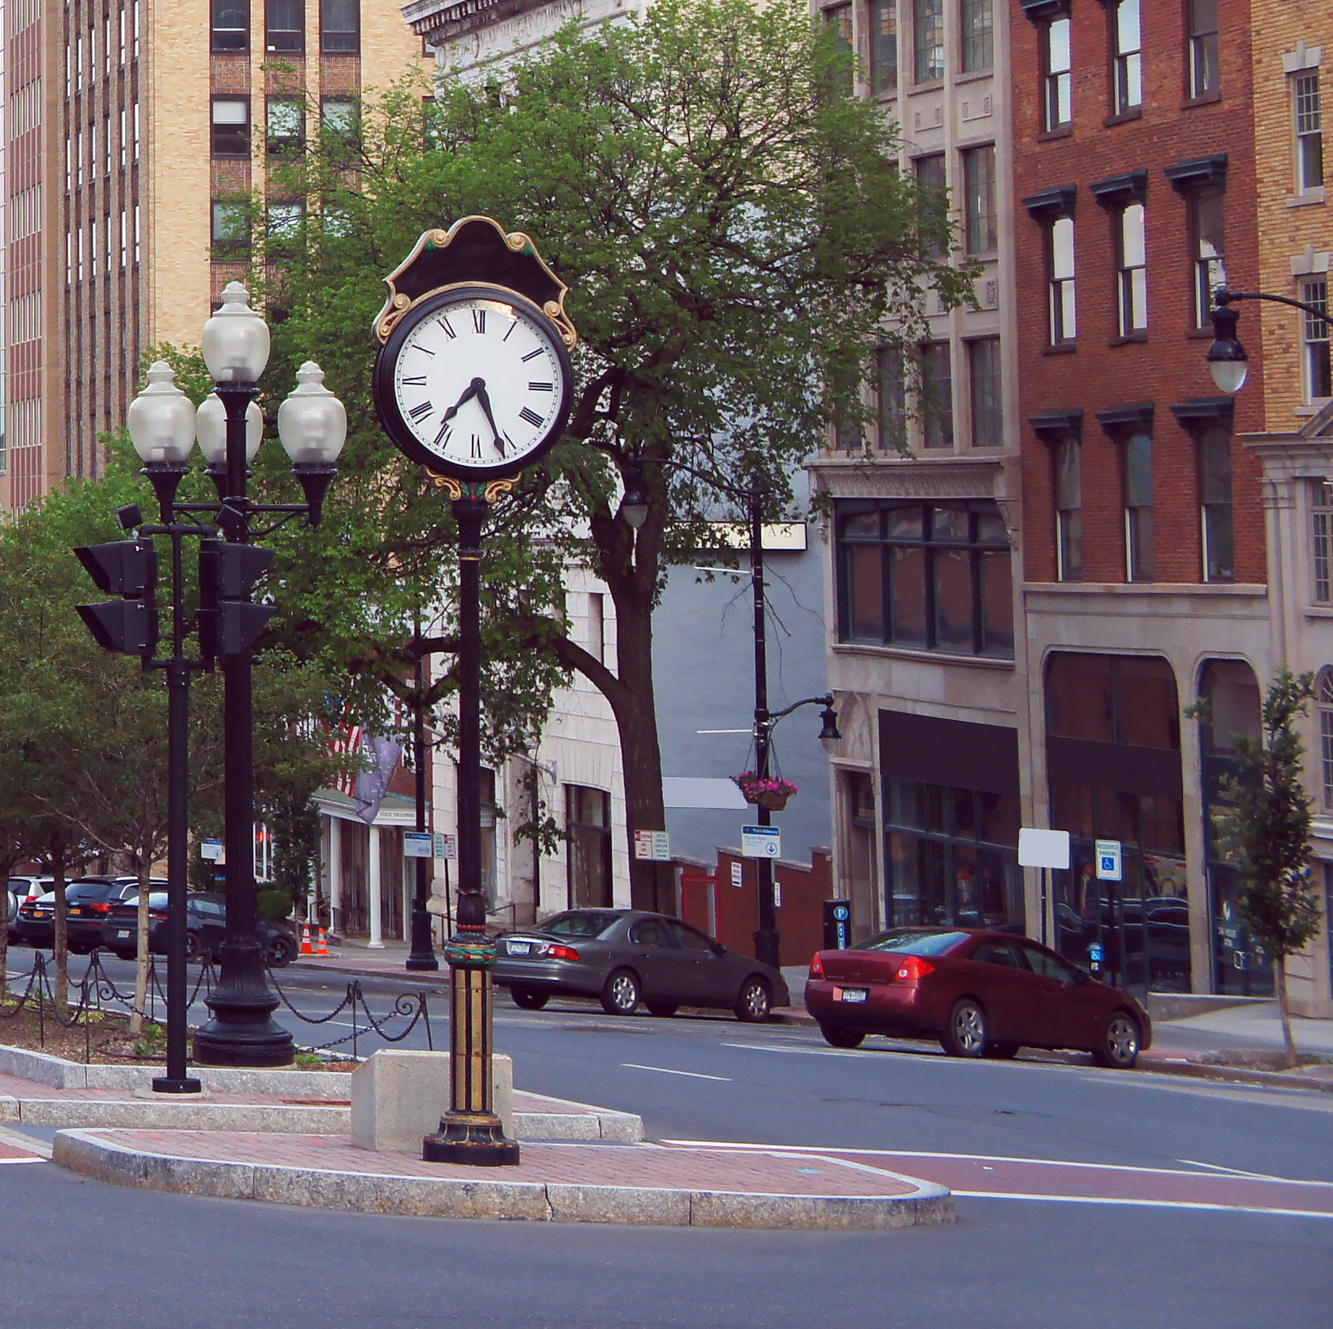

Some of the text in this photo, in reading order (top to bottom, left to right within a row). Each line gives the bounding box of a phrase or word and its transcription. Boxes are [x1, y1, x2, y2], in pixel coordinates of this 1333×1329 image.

[436, 315, 457, 342] XI
[471, 308, 487, 335] XII
[411, 339, 436, 361] X
[520, 346, 546, 363] II
[401, 373, 428, 387] IX
[527, 381, 554, 392] III
[433, 422, 455, 450] VII
[470, 433, 482, 459] VI
